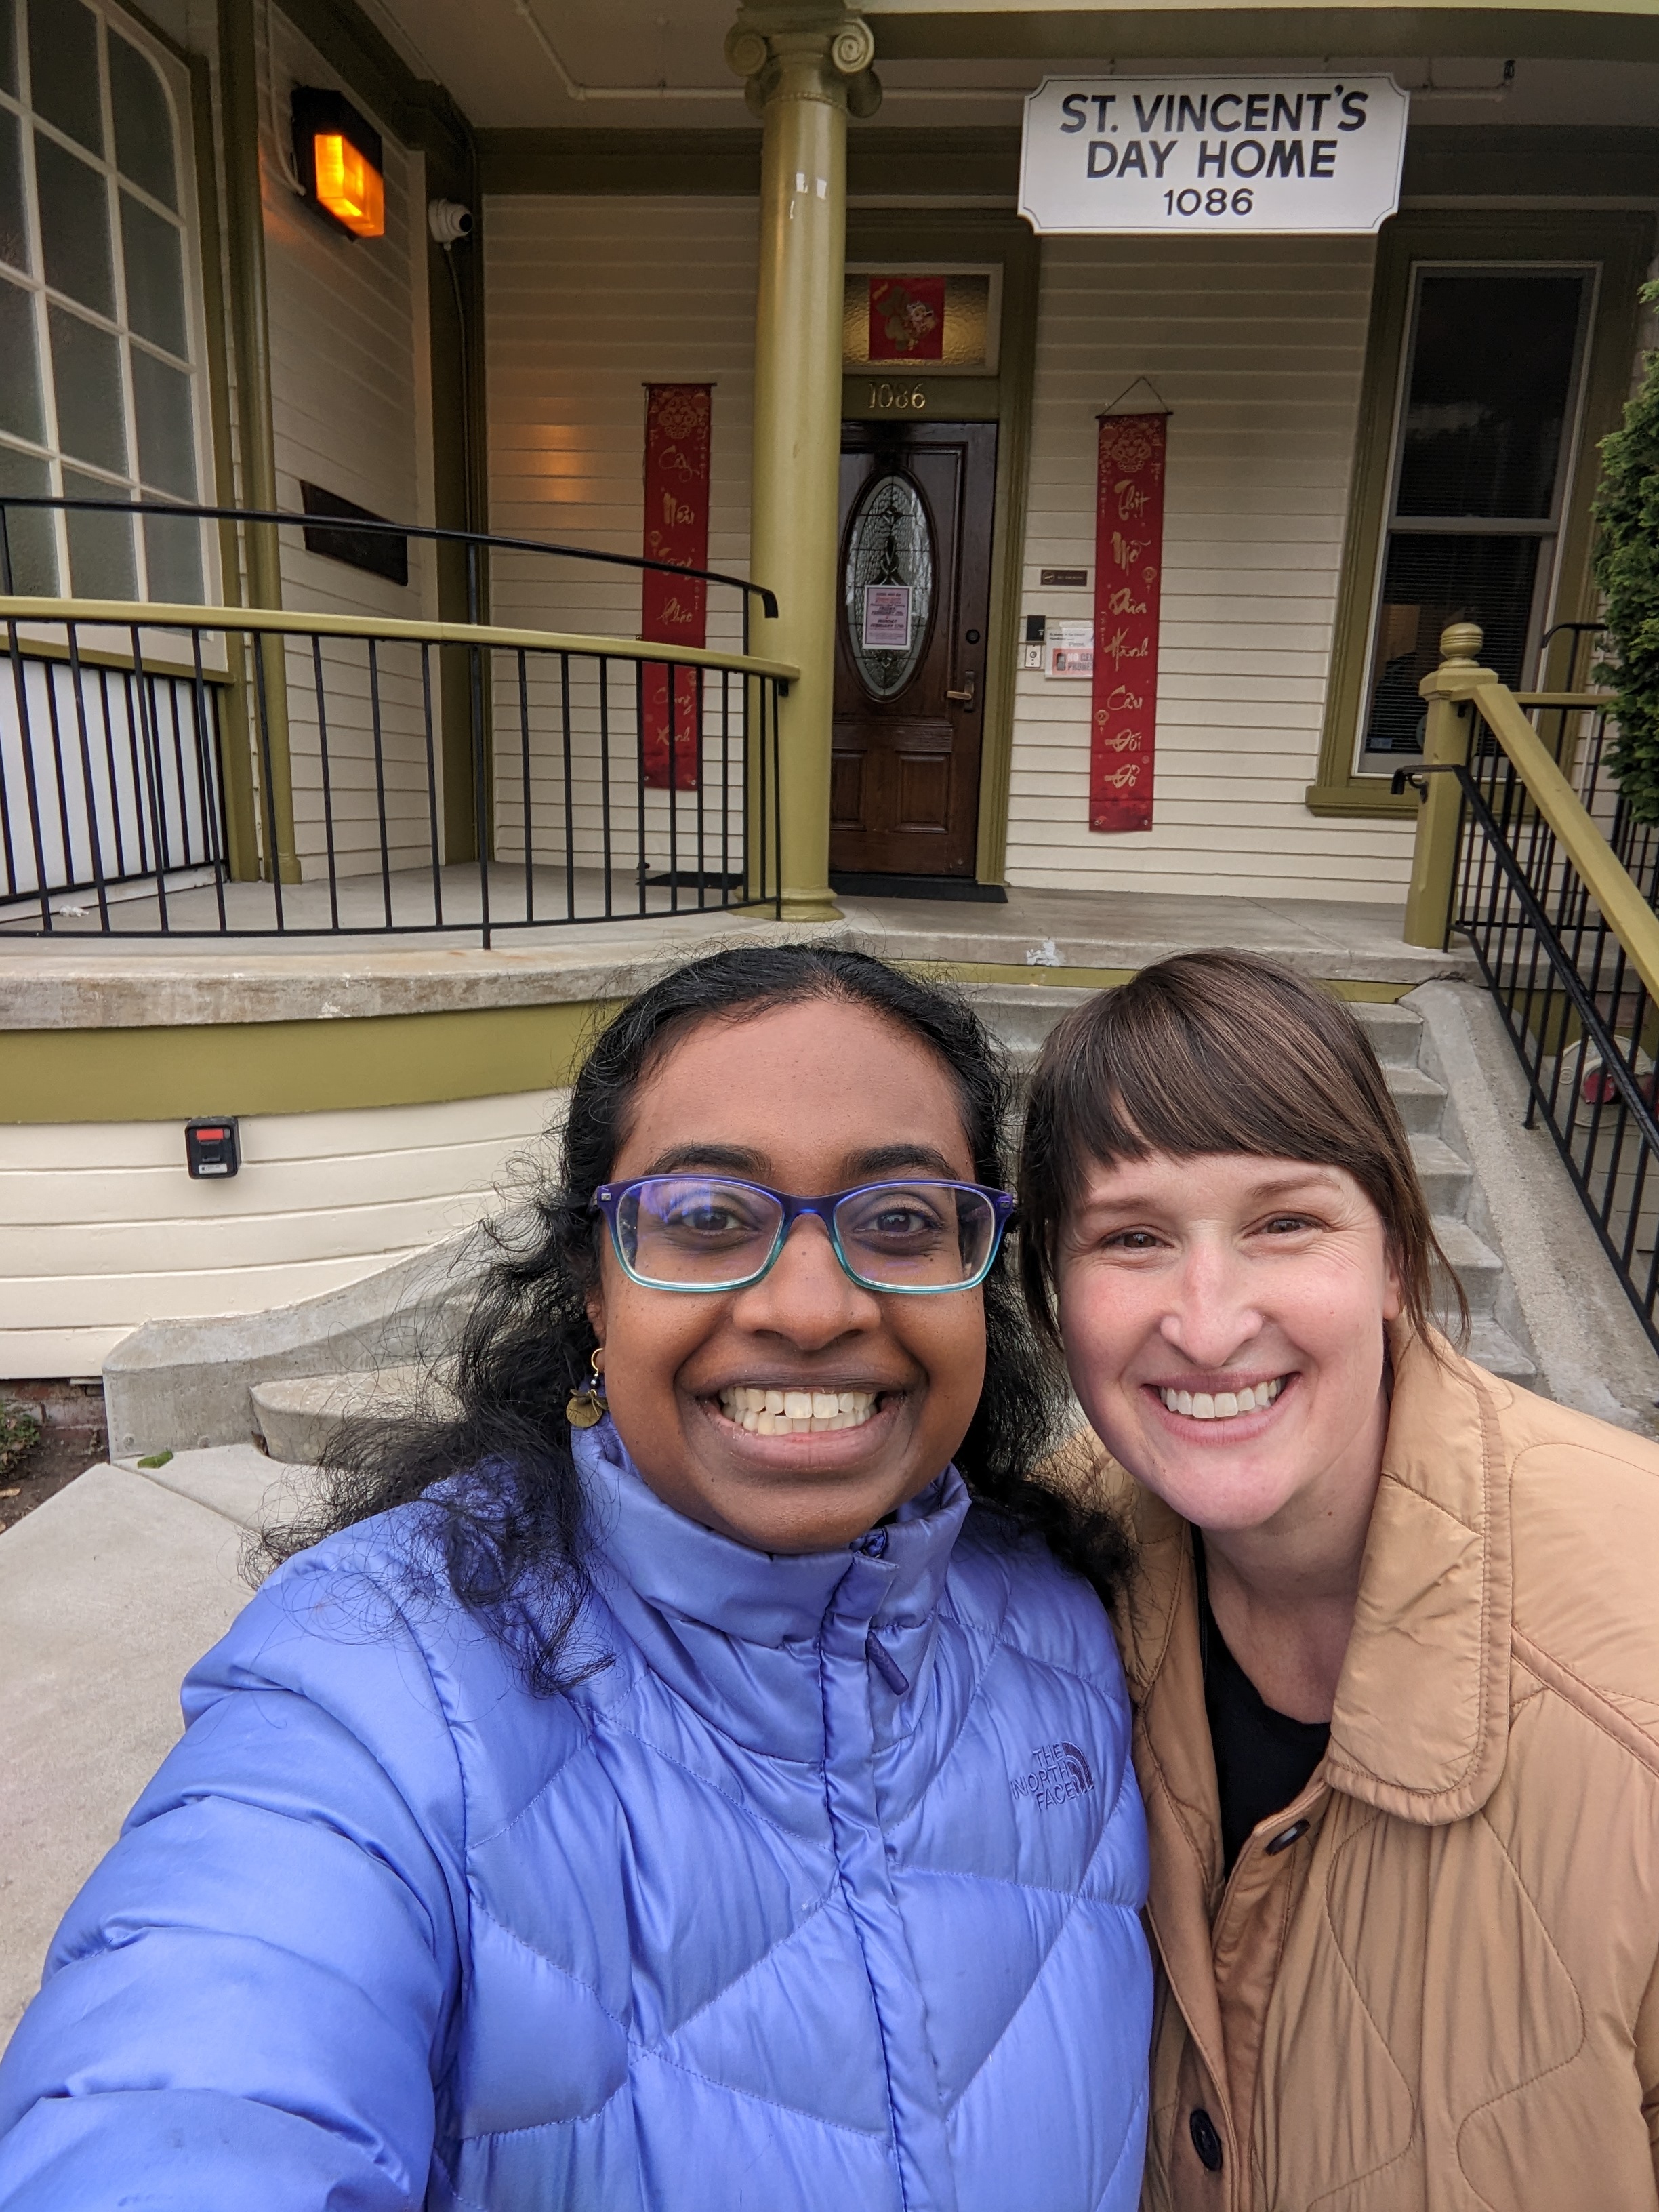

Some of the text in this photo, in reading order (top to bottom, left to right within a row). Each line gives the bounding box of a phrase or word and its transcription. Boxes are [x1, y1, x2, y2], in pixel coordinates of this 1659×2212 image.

[1061, 84, 1369, 134] ST. VINCENT'S
[1086, 139, 1338, 178] DAY HOME
[1163, 188, 1254, 216] 1086
[869, 382, 926, 409] 1086
[1032, 1742, 1065, 1767] THE
[1010, 1761, 1070, 1800] NORTH
[1036, 1781, 1076, 1813] FACE
